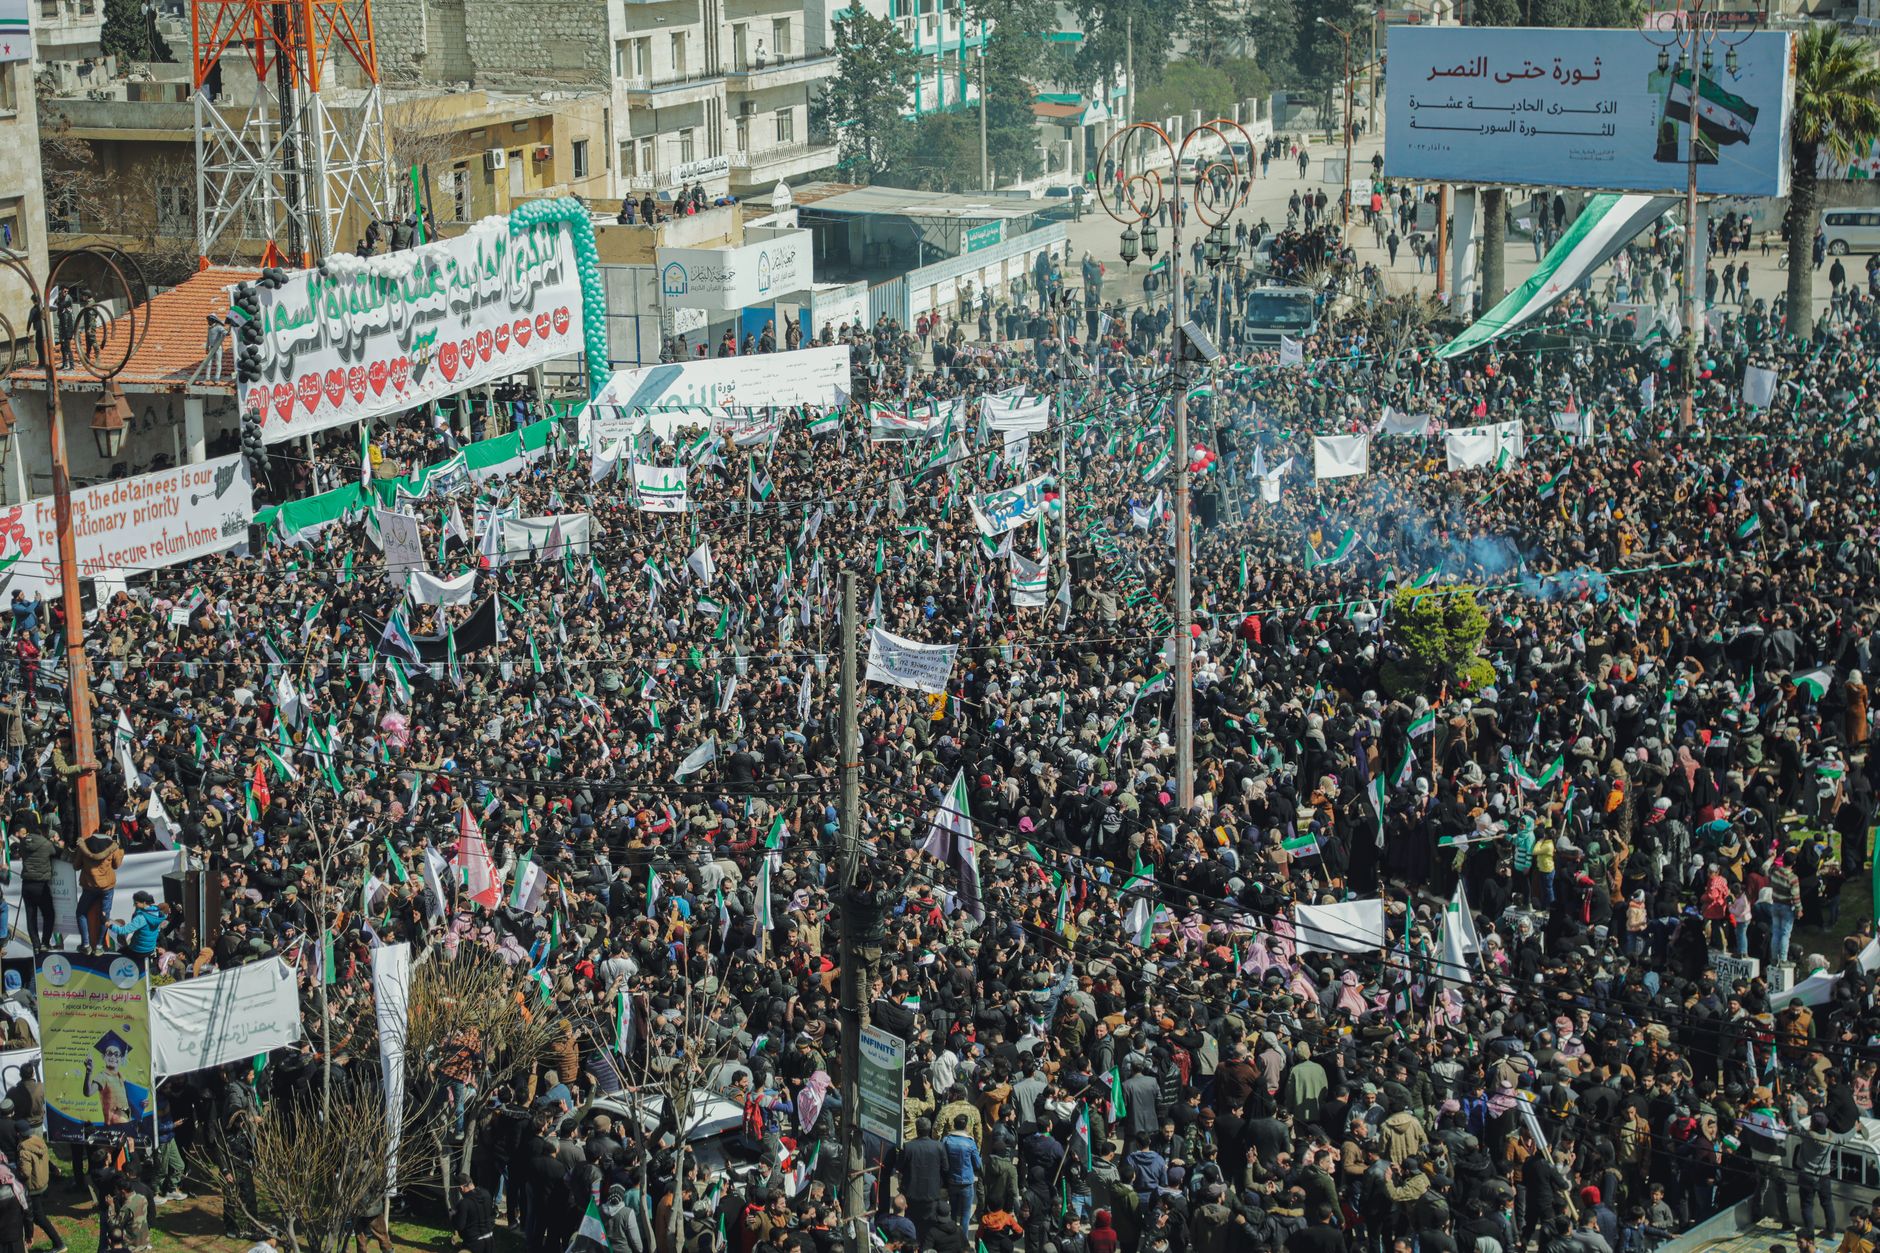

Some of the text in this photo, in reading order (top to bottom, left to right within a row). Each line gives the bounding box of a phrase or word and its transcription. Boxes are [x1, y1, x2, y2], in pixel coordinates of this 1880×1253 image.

[1427, 56, 1602, 85] ثورة حتى النصر
[1409, 95, 1617, 116] الذكرى الحادية عشرة
[1409, 116, 1616, 137] للثورة السورية
[446, 232, 511, 330] الحادية
[714, 270, 736, 282] جمعية
[537, 315, 551, 332] حلب
[555, 309, 569, 327] دمشق
[514, 324, 532, 337] حمص
[442, 348, 459, 370] درعا
[717, 379, 736, 394] ثورة
[36, 467, 213, 523] Freng the detainees is our
[38, 494, 180, 546] reutionary priority
[83, 544, 106, 577] and
[107, 545, 147, 567] secure
[150, 527, 187, 559] return
[186, 520, 218, 549] home
[1718, 961, 1750, 978] FATIMA
[88, 990, 109, 1001] دريم
[112, 991, 142, 1002] مدارس
[861, 1033, 896, 1057] INFINITE
